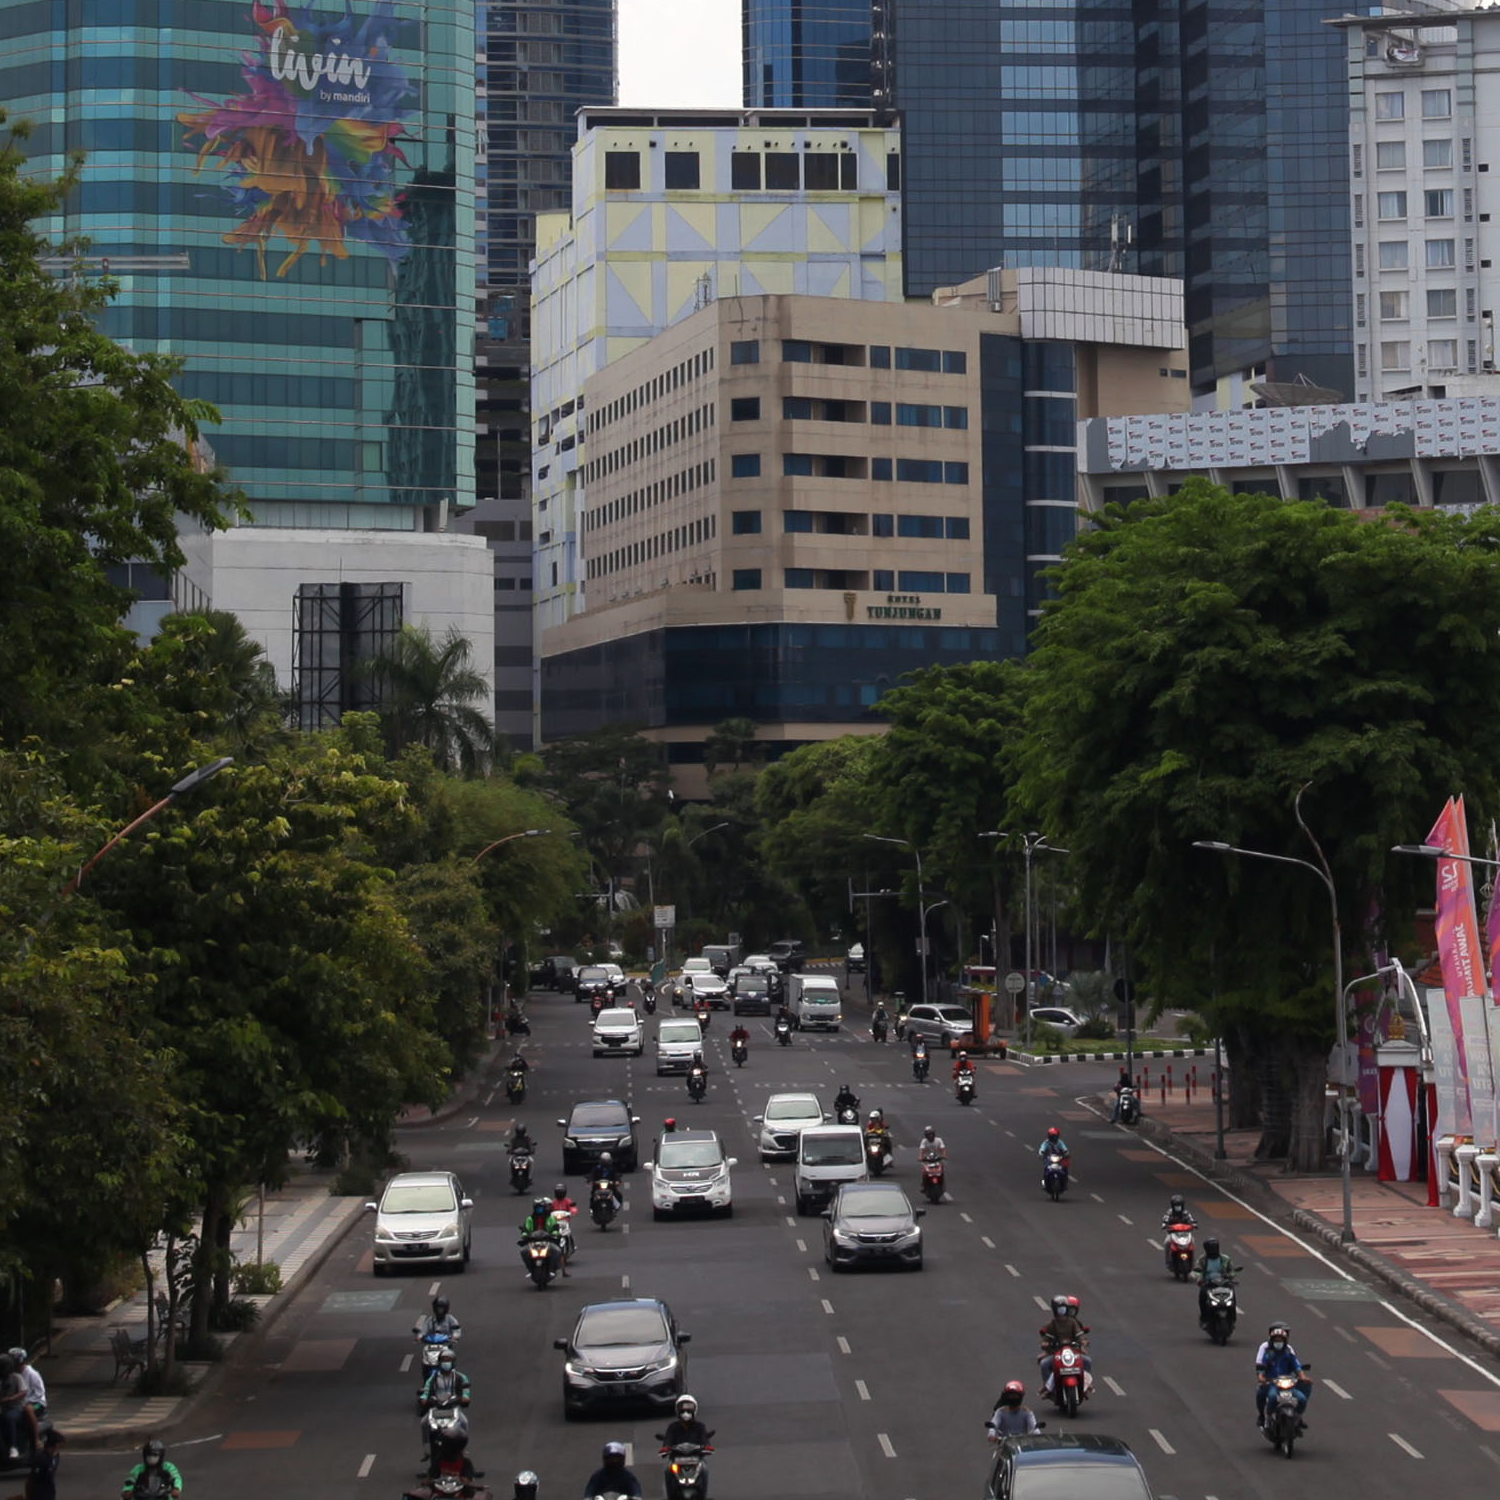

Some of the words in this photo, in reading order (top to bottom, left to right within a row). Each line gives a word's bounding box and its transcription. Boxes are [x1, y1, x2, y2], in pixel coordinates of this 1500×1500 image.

[270, 26, 371, 90] livin
[320, 89, 331, 103] by
[333, 91, 370, 103] mandiri
[887, 595, 921, 604] HOTEL
[867, 606, 942, 620] TUNJUNGAN
